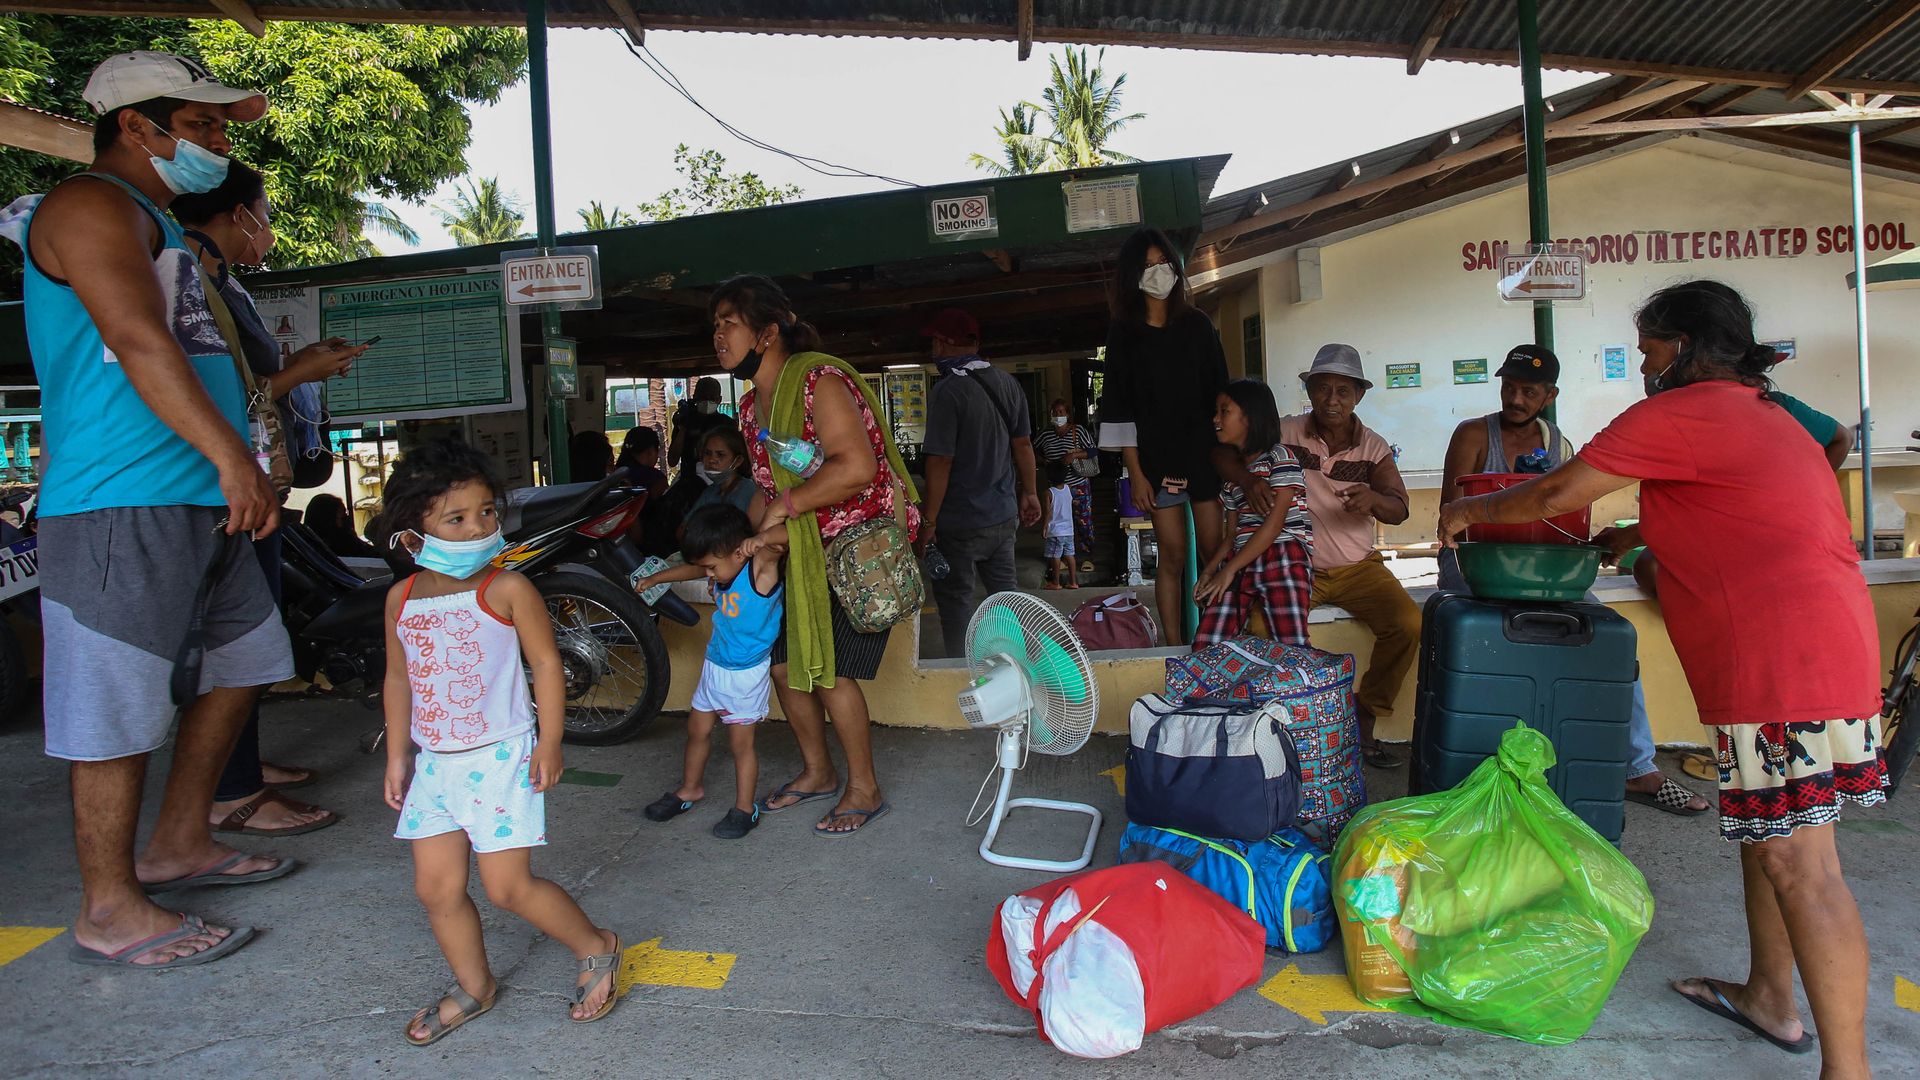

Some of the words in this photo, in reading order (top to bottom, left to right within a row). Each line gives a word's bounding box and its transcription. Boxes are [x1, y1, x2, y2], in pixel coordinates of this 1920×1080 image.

[936, 202, 960, 220] NO
[938, 218, 986, 231] SMOKING
[1647, 227, 1807, 261] INTEGRATED
[510, 261, 585, 282] ENTRANCE
[341, 285, 427, 304] EMERGENCY
[429, 279, 499, 296] HOTLINES
